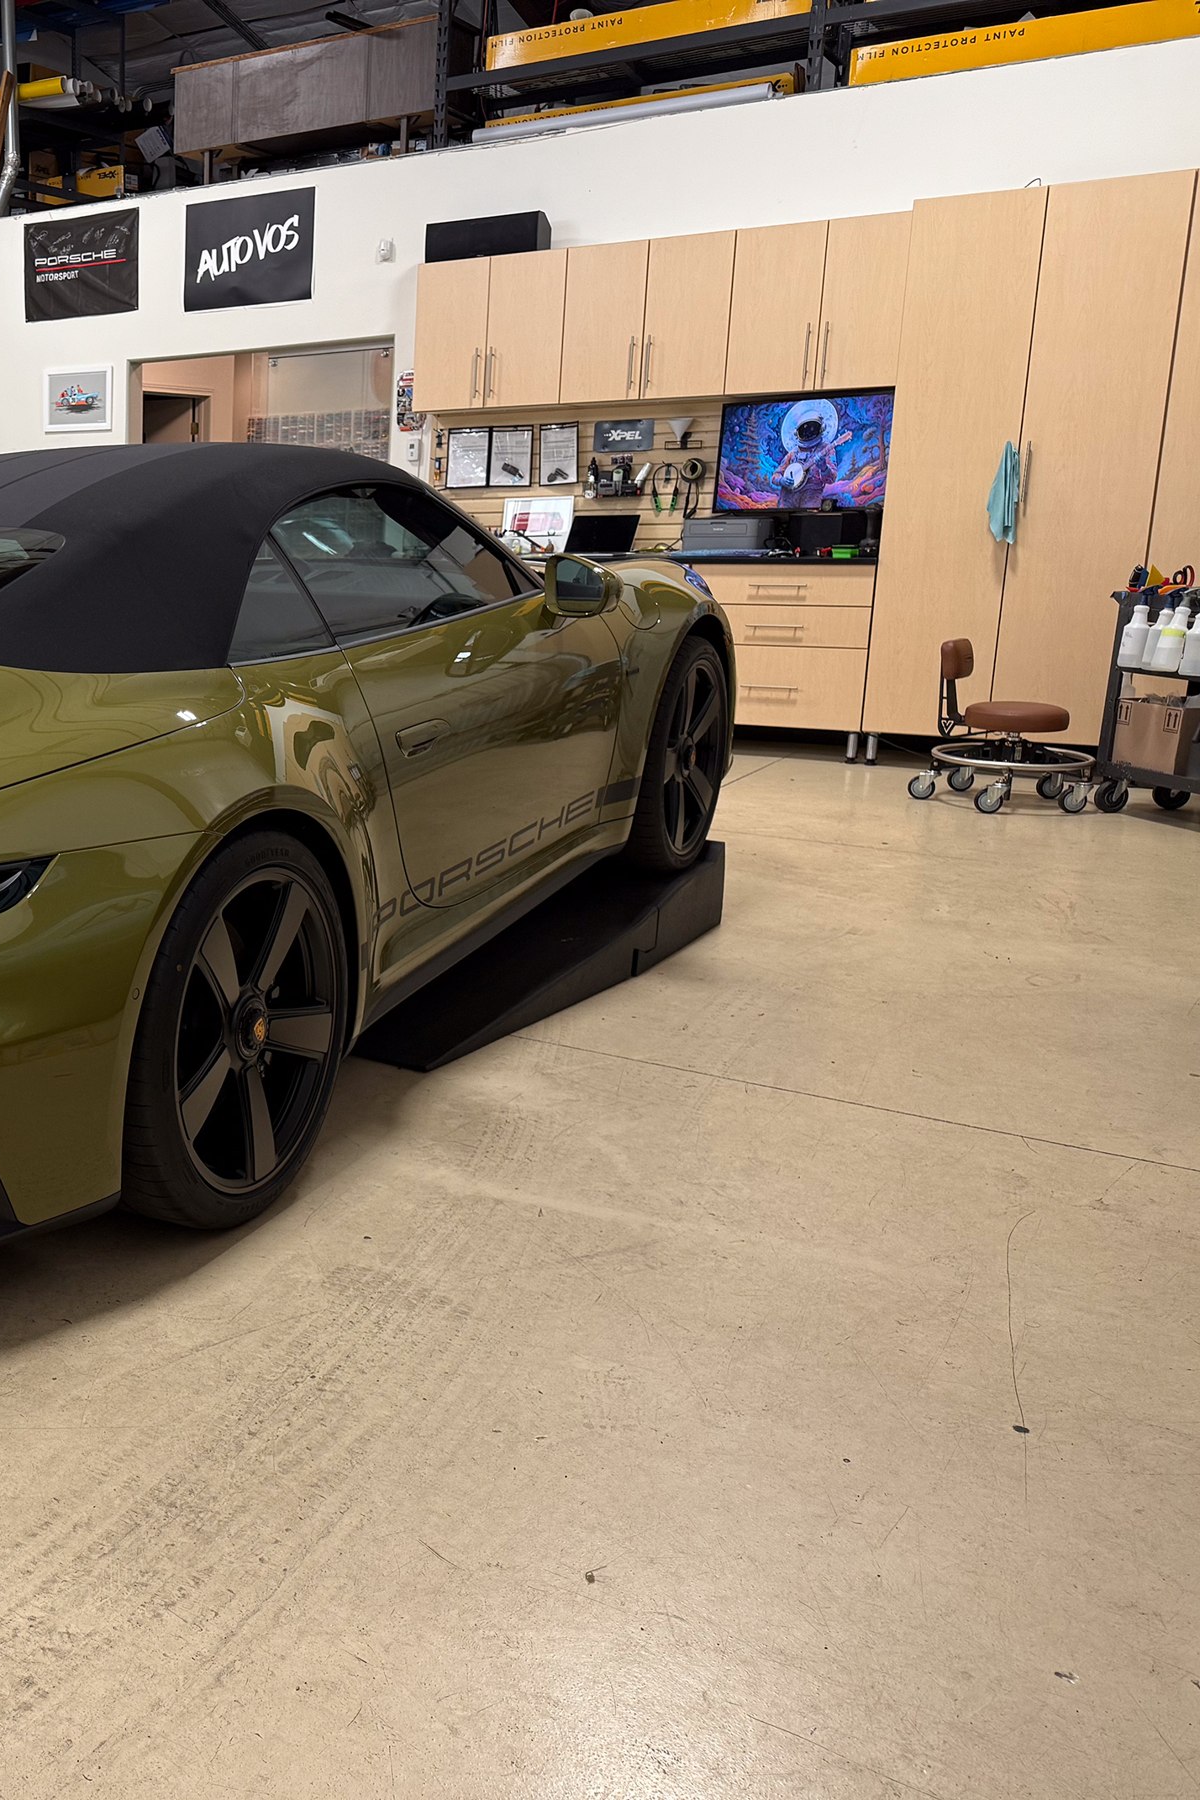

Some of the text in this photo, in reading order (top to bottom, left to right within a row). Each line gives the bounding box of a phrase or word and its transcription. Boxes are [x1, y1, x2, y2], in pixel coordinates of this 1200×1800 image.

[491, 17, 623, 49] PAINT PROTECTION FILM
[856, 28, 1025, 61] PAINT PROTECTION FILM
[35, 249, 117, 268] PORSCHE
[607, 429, 643, 442] XPEL
[373, 790, 597, 932] PORSCHE
